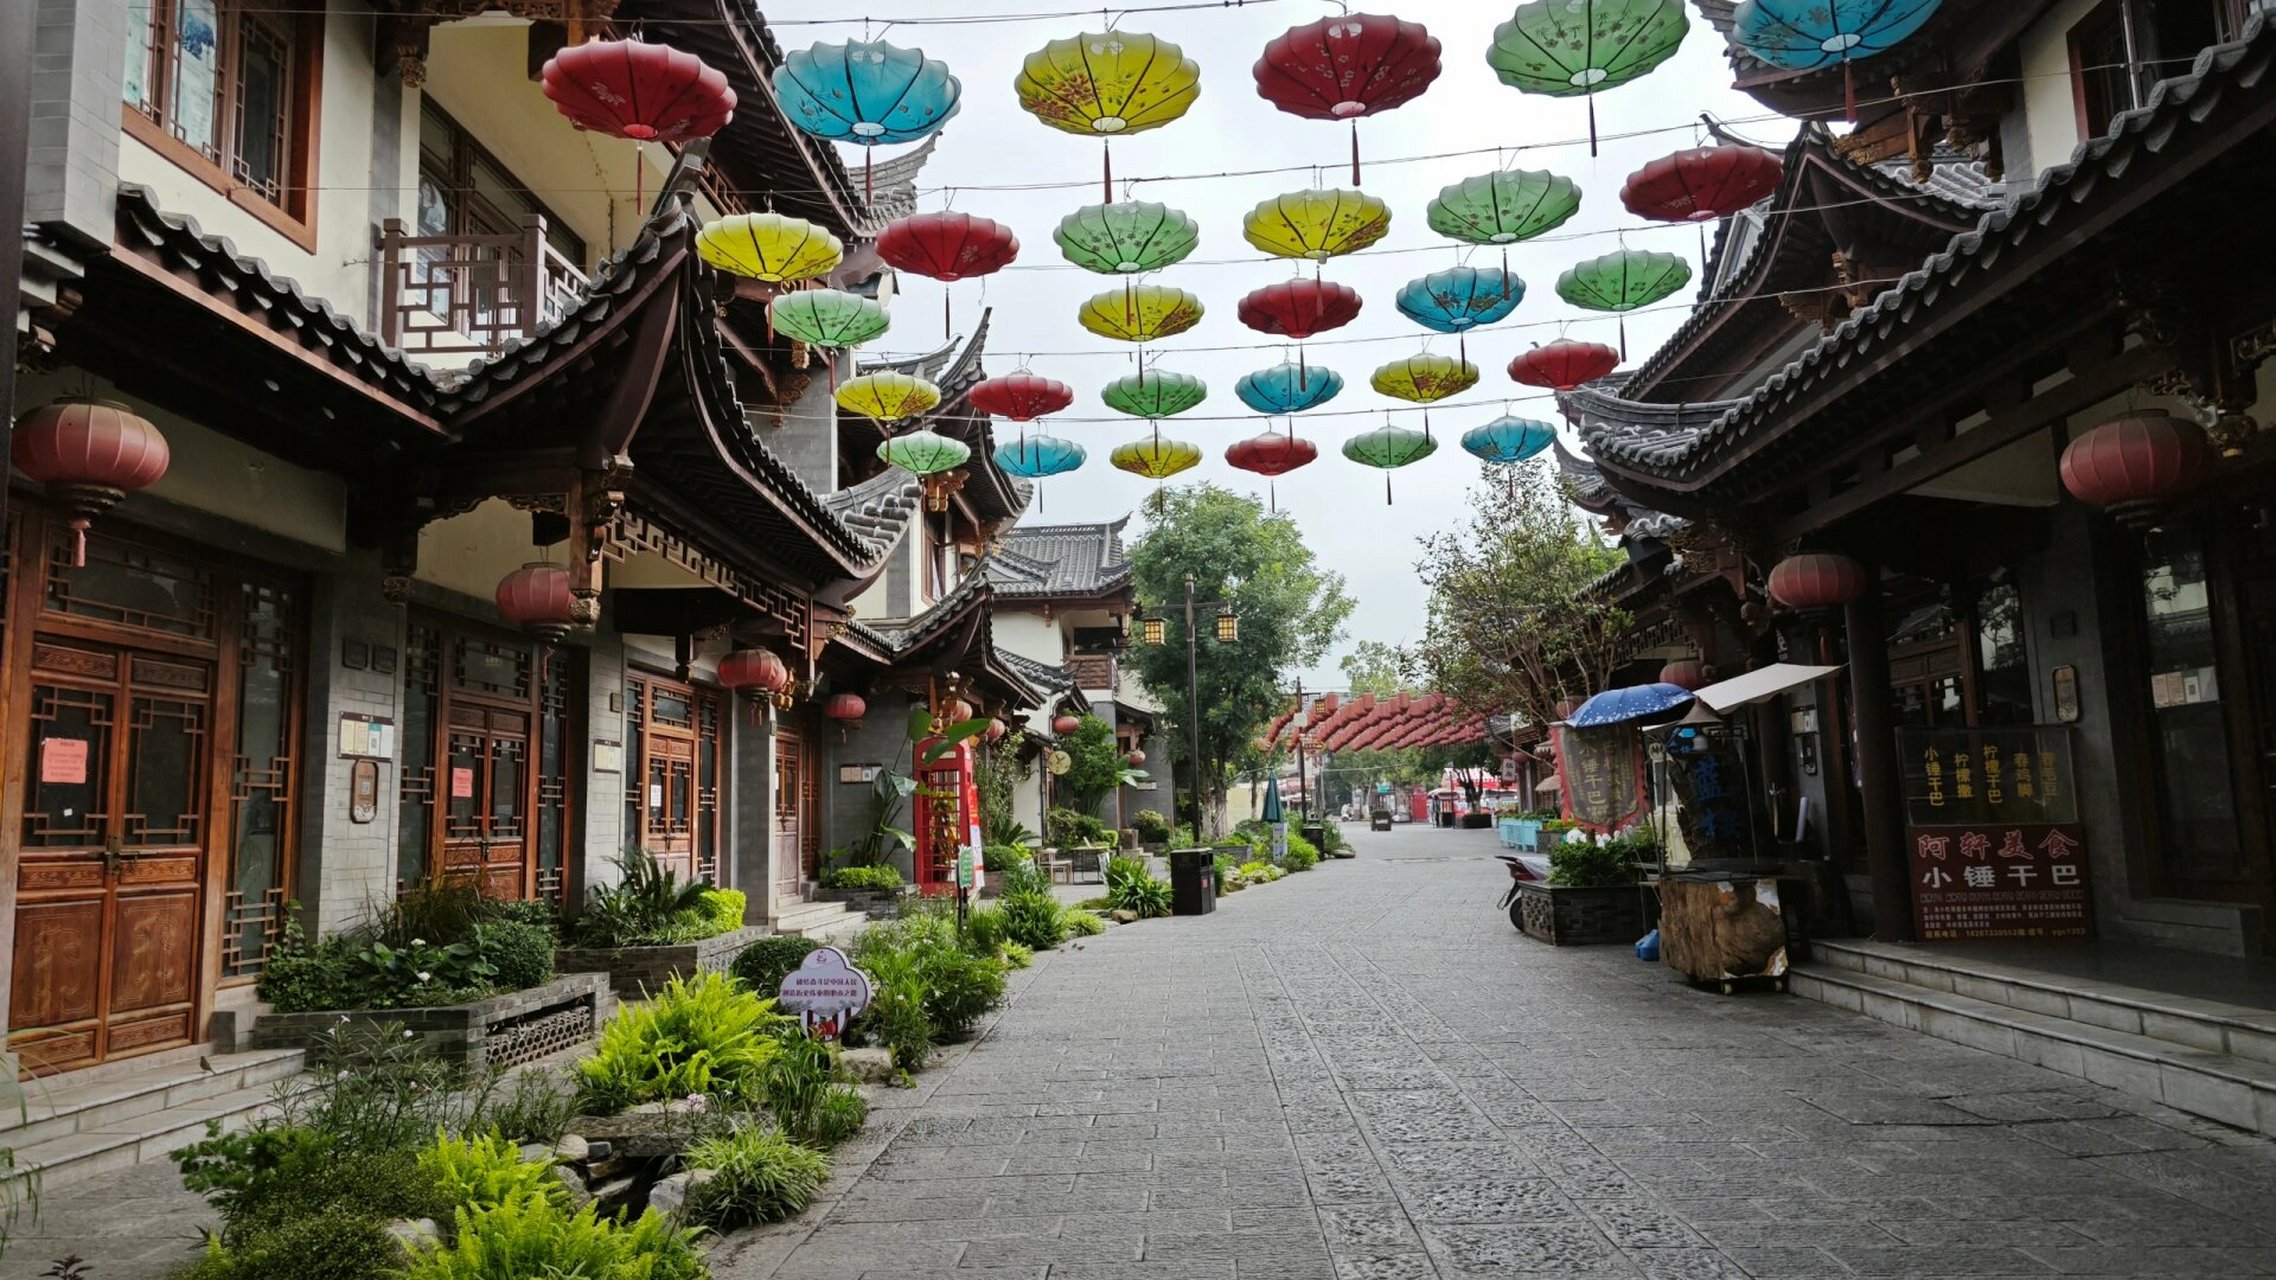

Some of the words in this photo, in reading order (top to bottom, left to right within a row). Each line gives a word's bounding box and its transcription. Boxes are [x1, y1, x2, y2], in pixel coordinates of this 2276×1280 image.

[1924, 746, 1945, 807] 小锤干巴
[1983, 745, 2003, 804] 柠檬干巴
[1917, 828, 2080, 861] 阿轩美食
[1922, 864, 2081, 889] 小锤干巴
